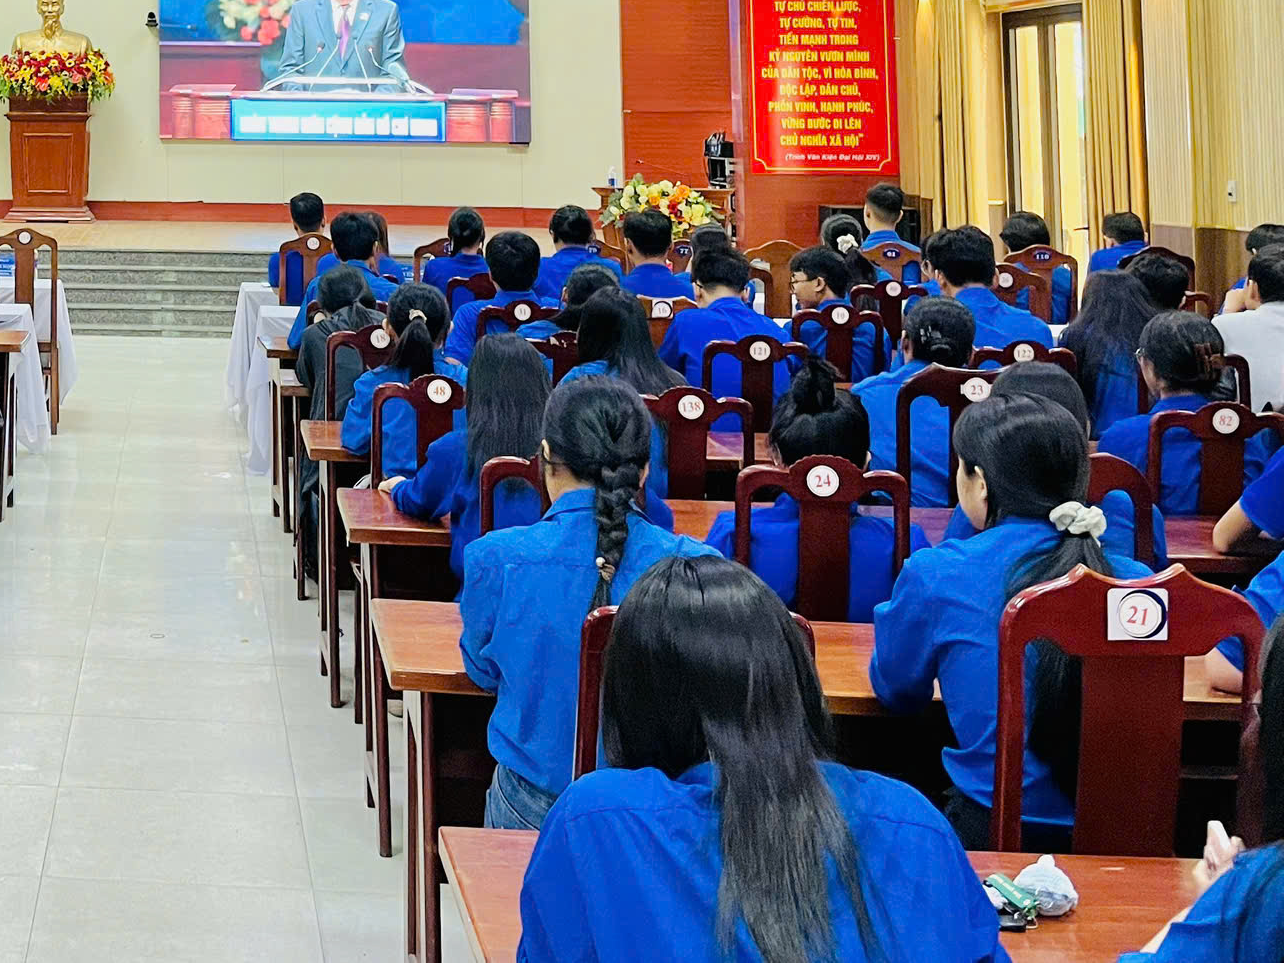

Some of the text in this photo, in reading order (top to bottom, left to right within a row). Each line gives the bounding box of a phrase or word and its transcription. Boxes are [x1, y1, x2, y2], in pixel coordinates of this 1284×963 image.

[375, 334, 386, 343] 18
[752, 345, 768, 356] 121
[1017, 349, 1032, 358] 122
[433, 386, 445, 396] 48
[970, 384, 983, 395] 23
[682, 401, 701, 412] 138
[1219, 415, 1233, 426] 82
[815, 474, 831, 487] 24
[1126, 605, 1147, 626] 21
